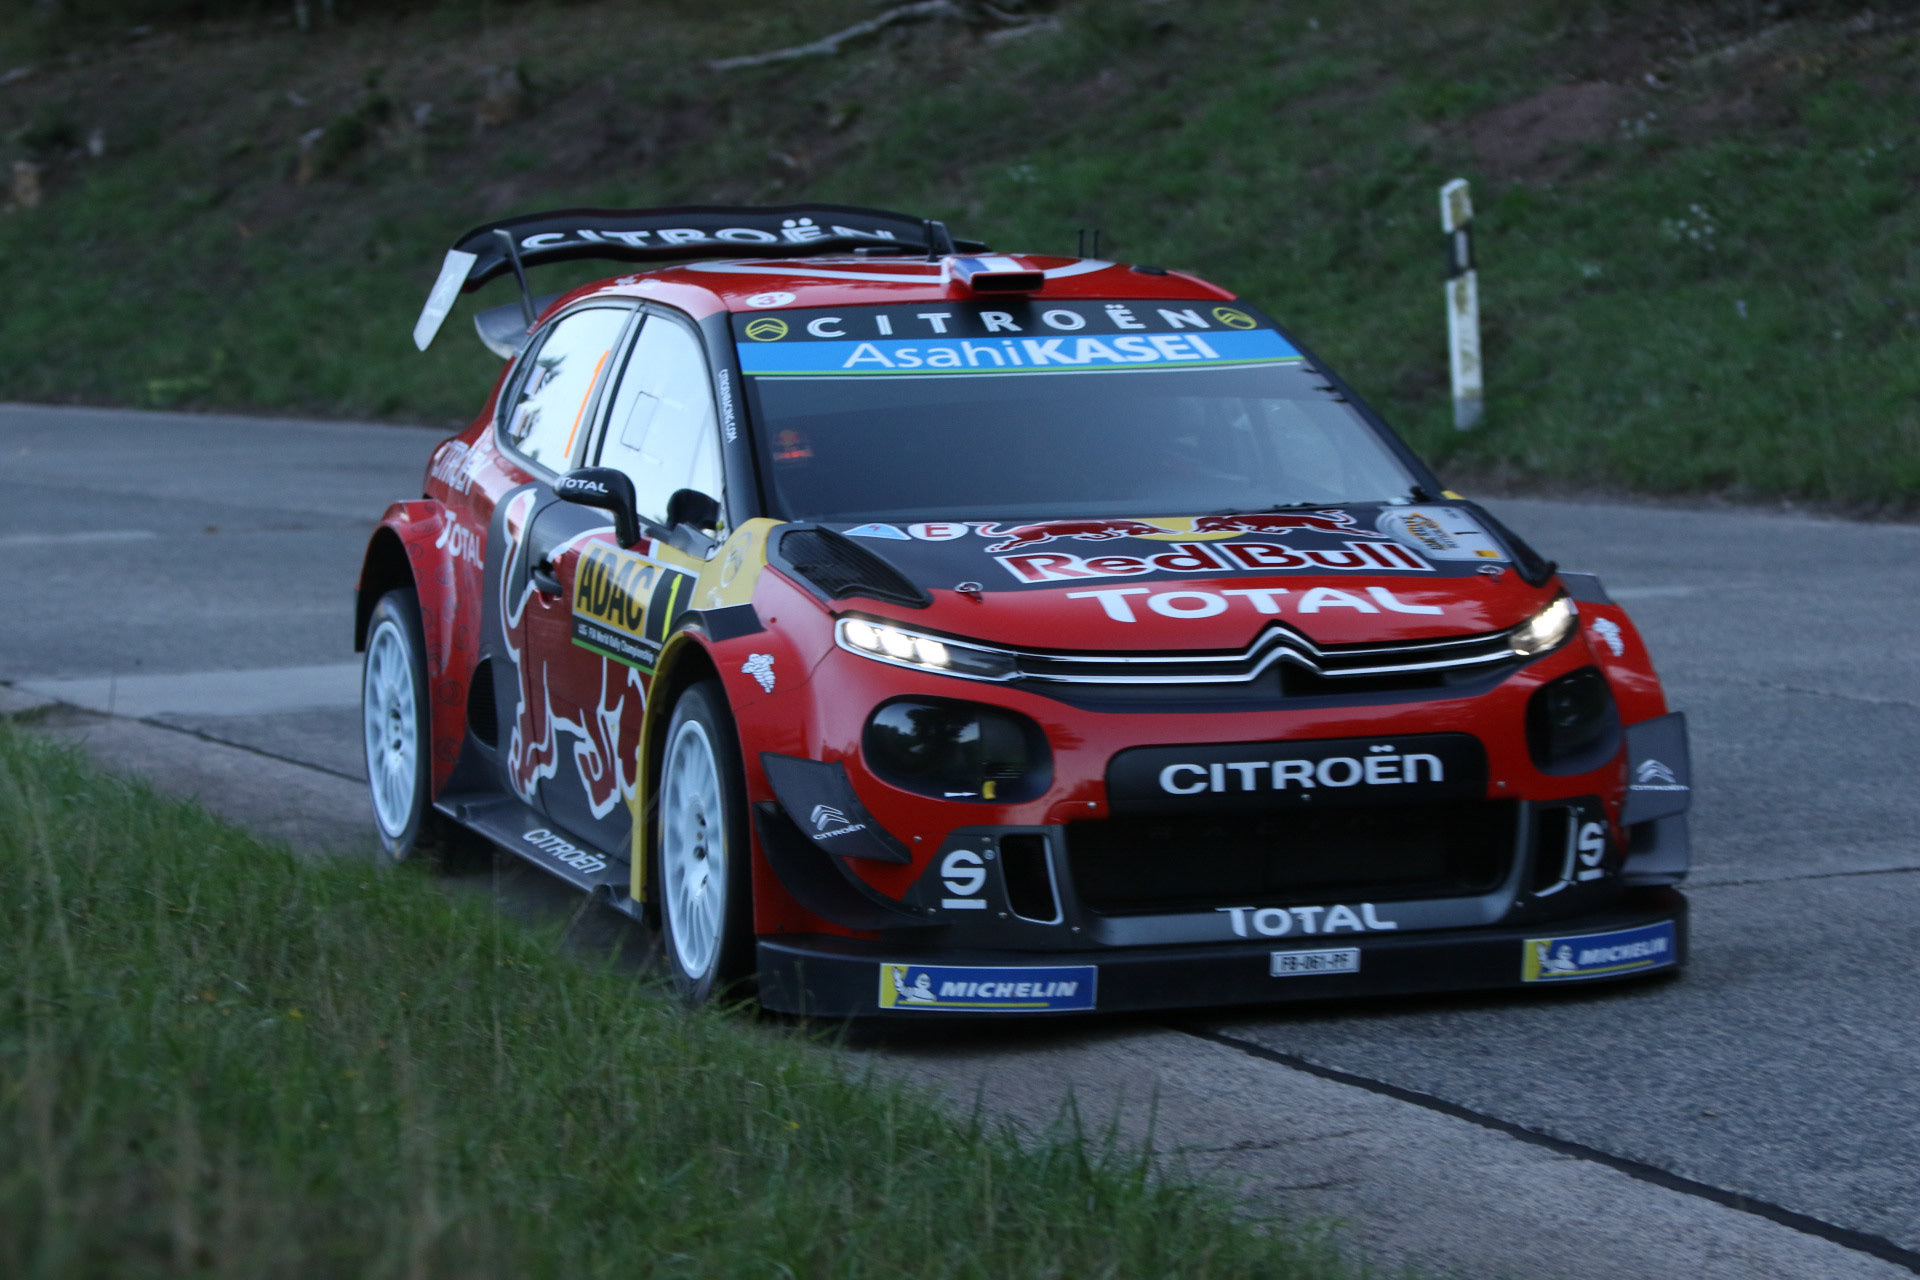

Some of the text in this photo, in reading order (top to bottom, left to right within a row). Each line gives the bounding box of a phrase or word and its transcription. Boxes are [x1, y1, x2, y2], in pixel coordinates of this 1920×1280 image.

[806, 304, 1211, 338] CITROËN
[558, 477, 609, 493] TOTAL
[435, 509, 484, 570] TOTAL
[925, 523, 952, 538] E
[995, 540, 1437, 583] Red Bull
[577, 547, 655, 630] ADAC
[1067, 586, 1445, 623] TOTAL
[661, 573, 684, 643] 1
[1158, 745, 1445, 795] CITROËN
[1215, 902, 1398, 938] TOTAL
[1577, 936, 1669, 966] MICHELIN
[939, 981, 1079, 998] MICHELIN
